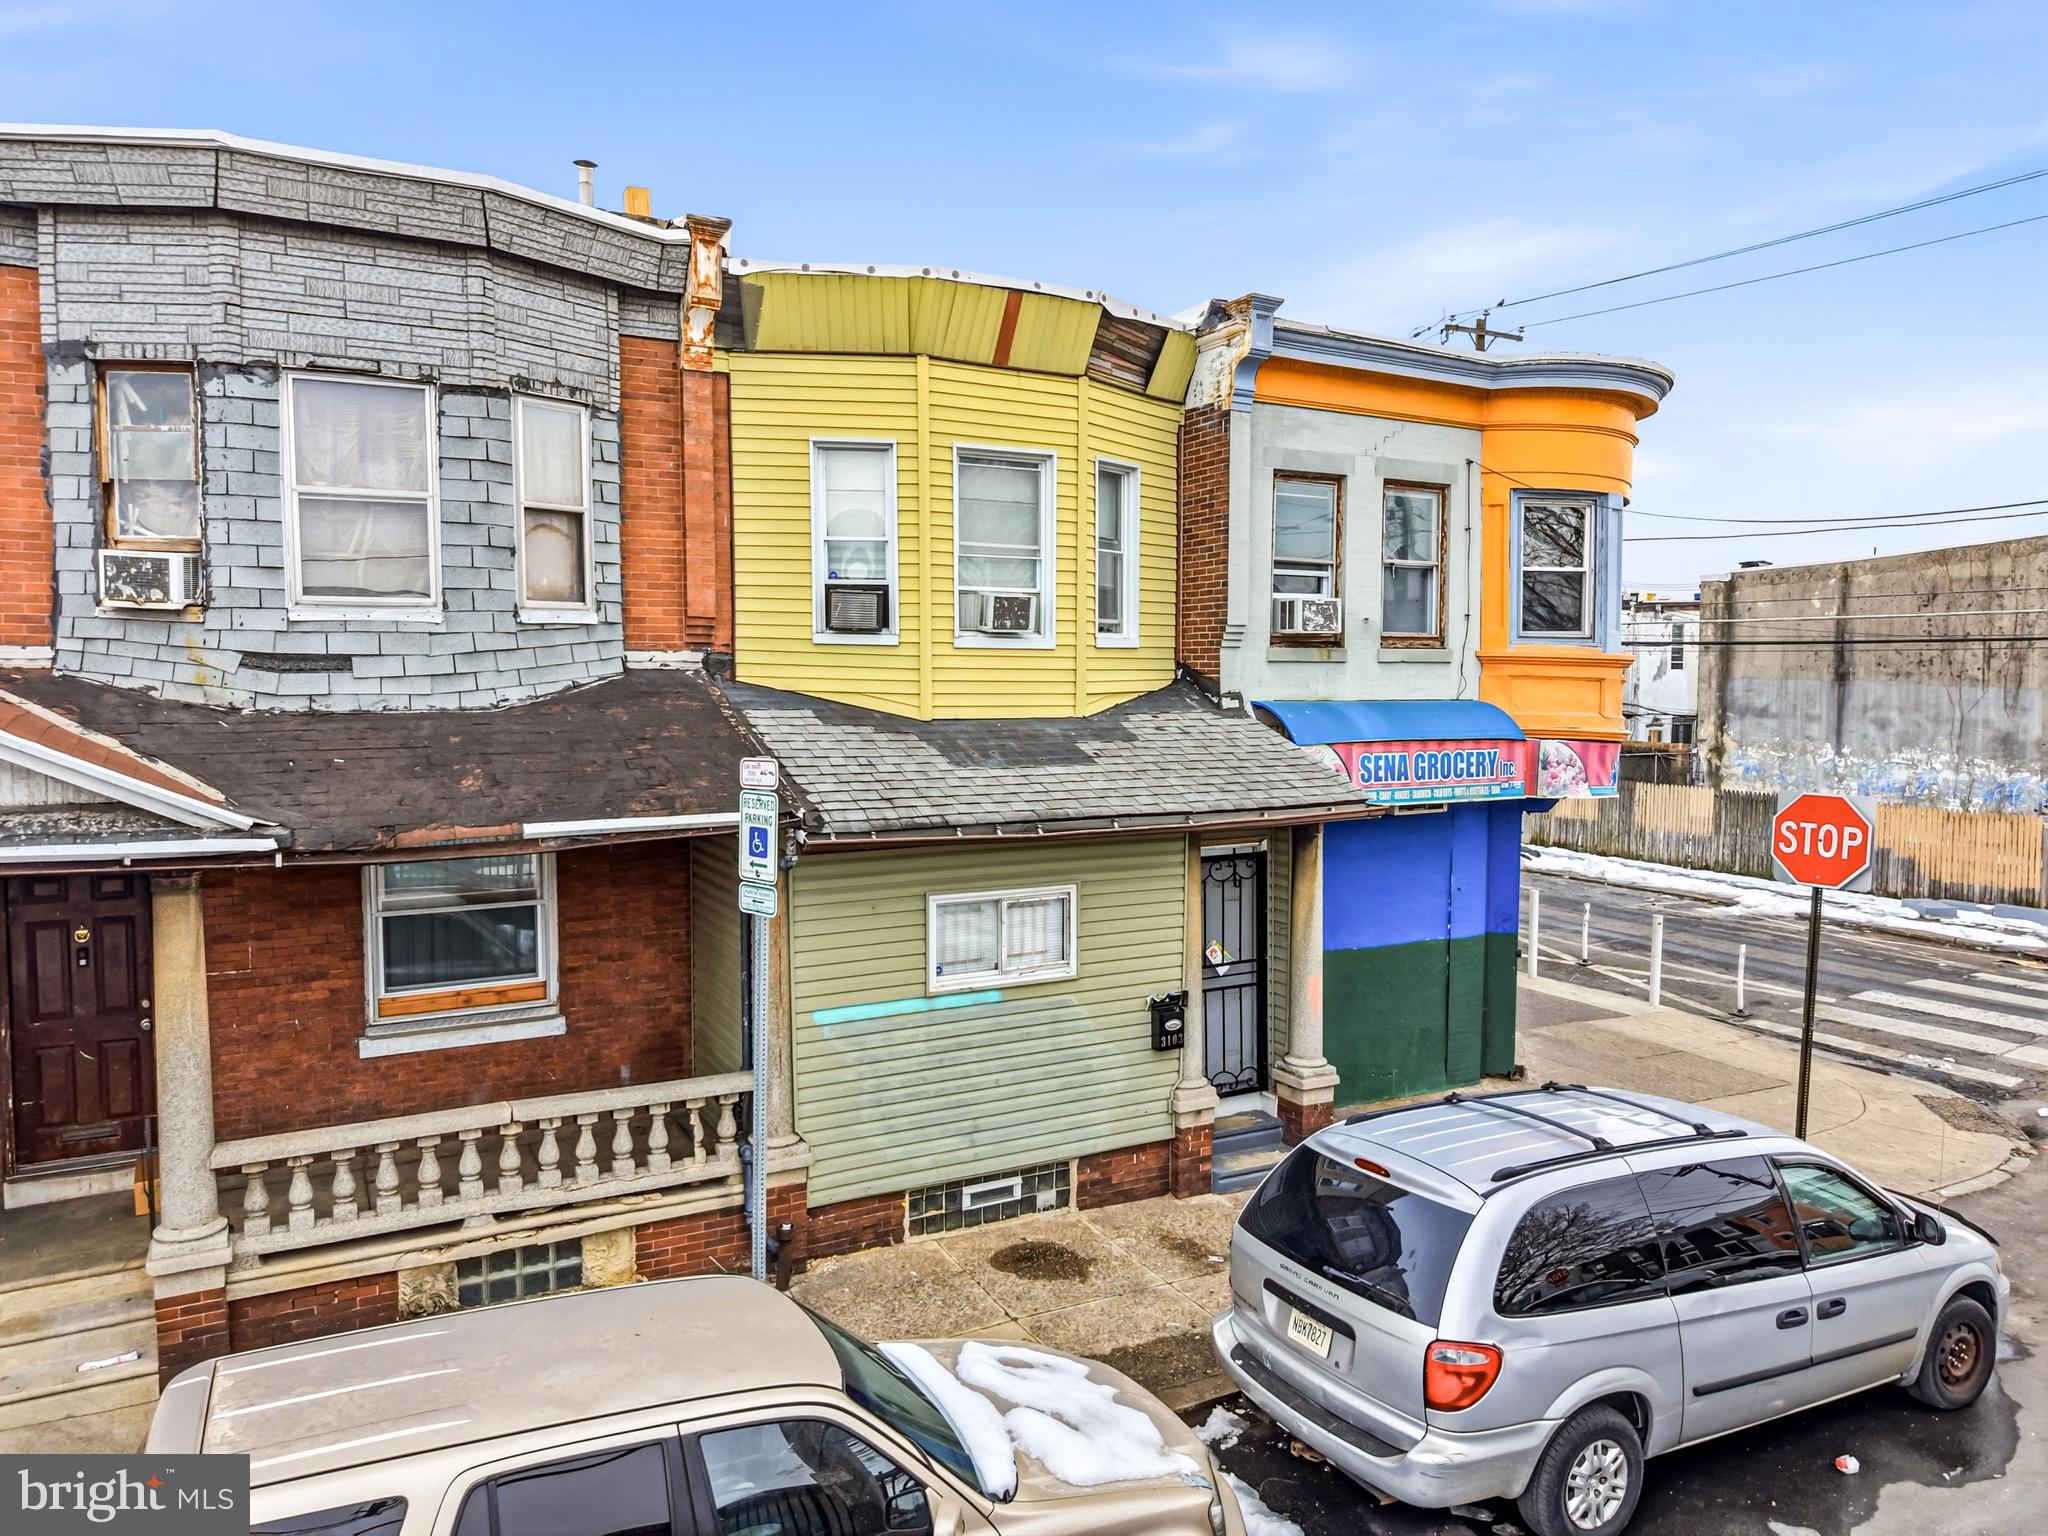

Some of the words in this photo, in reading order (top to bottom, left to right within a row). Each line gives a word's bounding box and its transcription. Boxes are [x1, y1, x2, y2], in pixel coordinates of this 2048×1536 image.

[1360, 753, 1409, 784] SENA
[1413, 750, 1499, 782] GROCERY
[1500, 760, 1516, 776] Inc.
[744, 797, 775, 811] RESERVED
[745, 812, 773, 827] PARKING
[1779, 820, 1863, 860] STOP
[1161, 1033, 1183, 1047] 3103
[1303, 1277, 1340, 1300] CARAVAN
